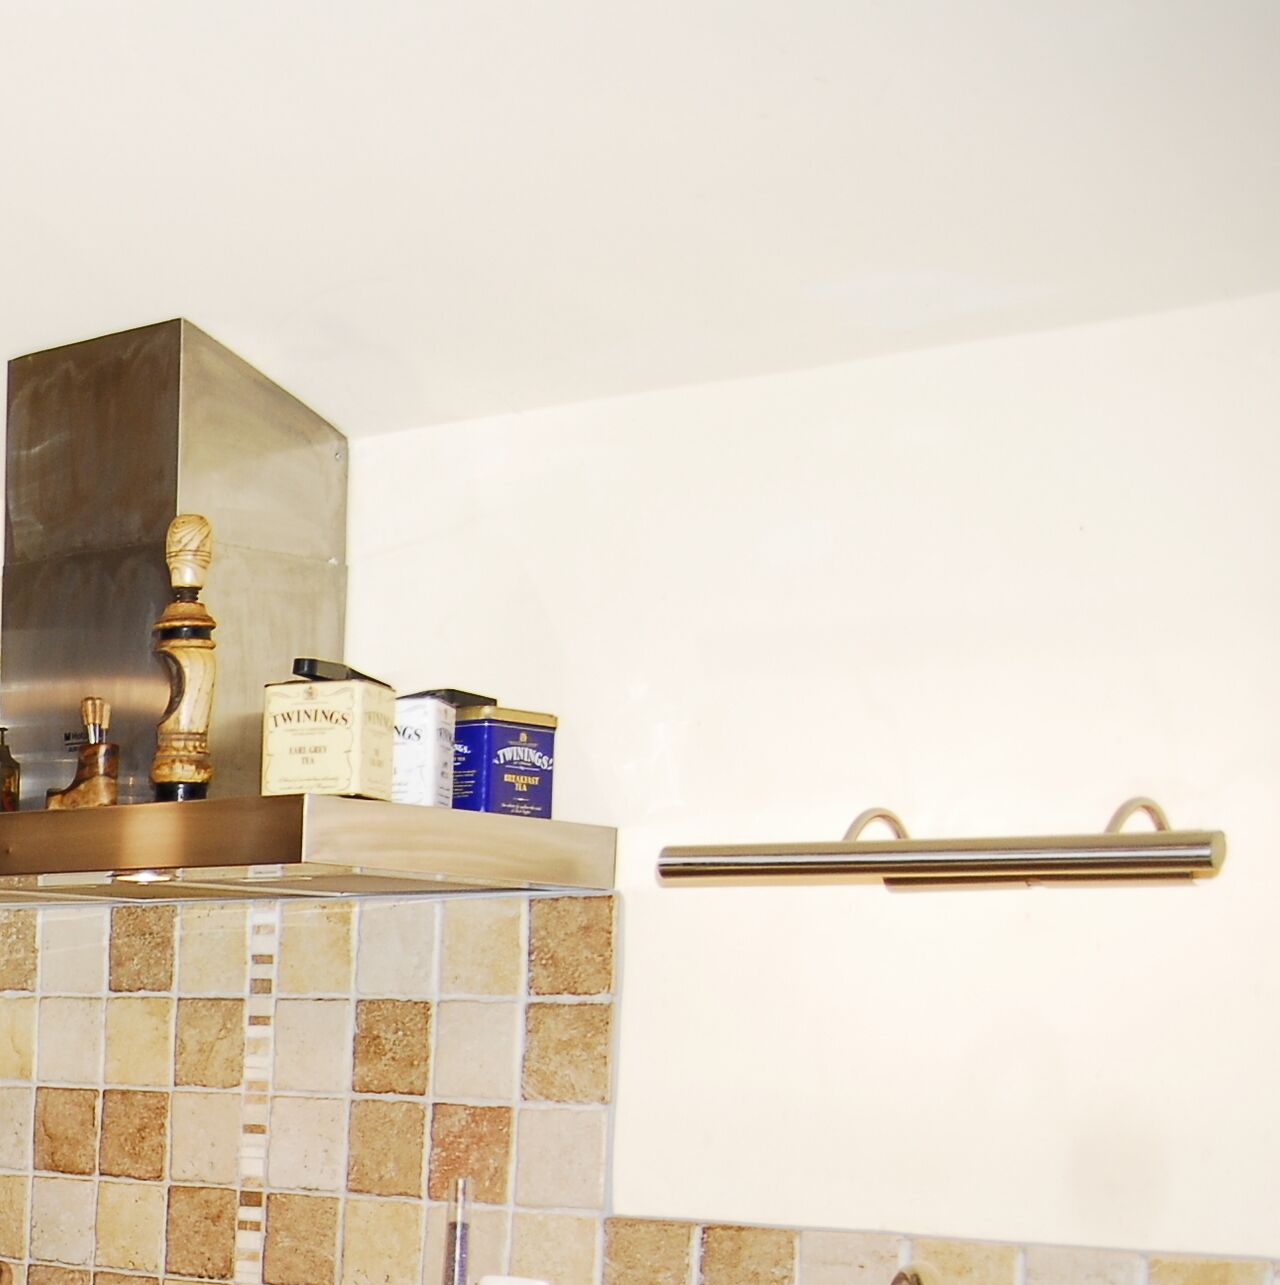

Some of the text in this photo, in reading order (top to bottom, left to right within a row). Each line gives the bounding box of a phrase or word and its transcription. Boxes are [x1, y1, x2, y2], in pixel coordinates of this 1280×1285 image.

[271, 708, 349, 728] TWININGS
[496, 746, 549, 770] TWININGS
[514, 783, 527, 792] TEA
